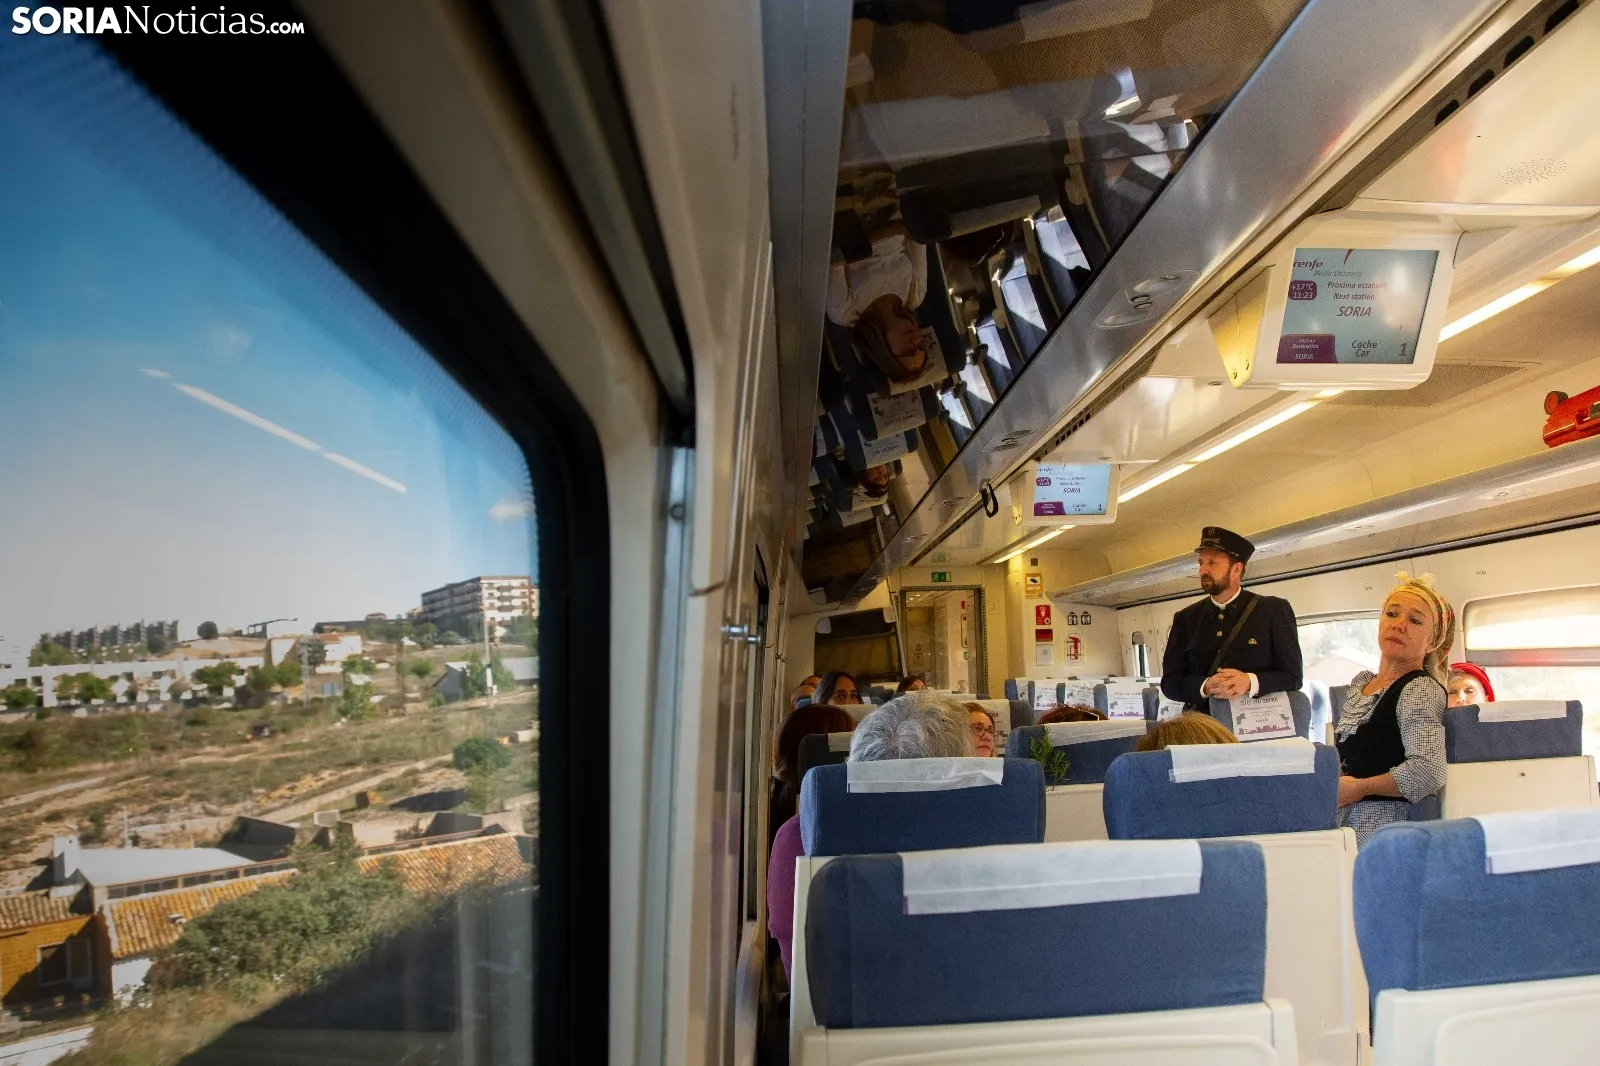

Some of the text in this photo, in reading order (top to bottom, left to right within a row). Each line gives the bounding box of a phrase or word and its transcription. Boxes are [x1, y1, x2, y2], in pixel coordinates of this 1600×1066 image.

[1293, 259, 1323, 270] renfe
[1333, 292, 1350, 300] Next
[1337, 306, 1372, 317] SORIA
[1351, 339, 1378, 349] Coche
[1355, 348, 1371, 357] Car
[1398, 343, 1407, 357] 1
[1097, 503, 1103, 511] 1
